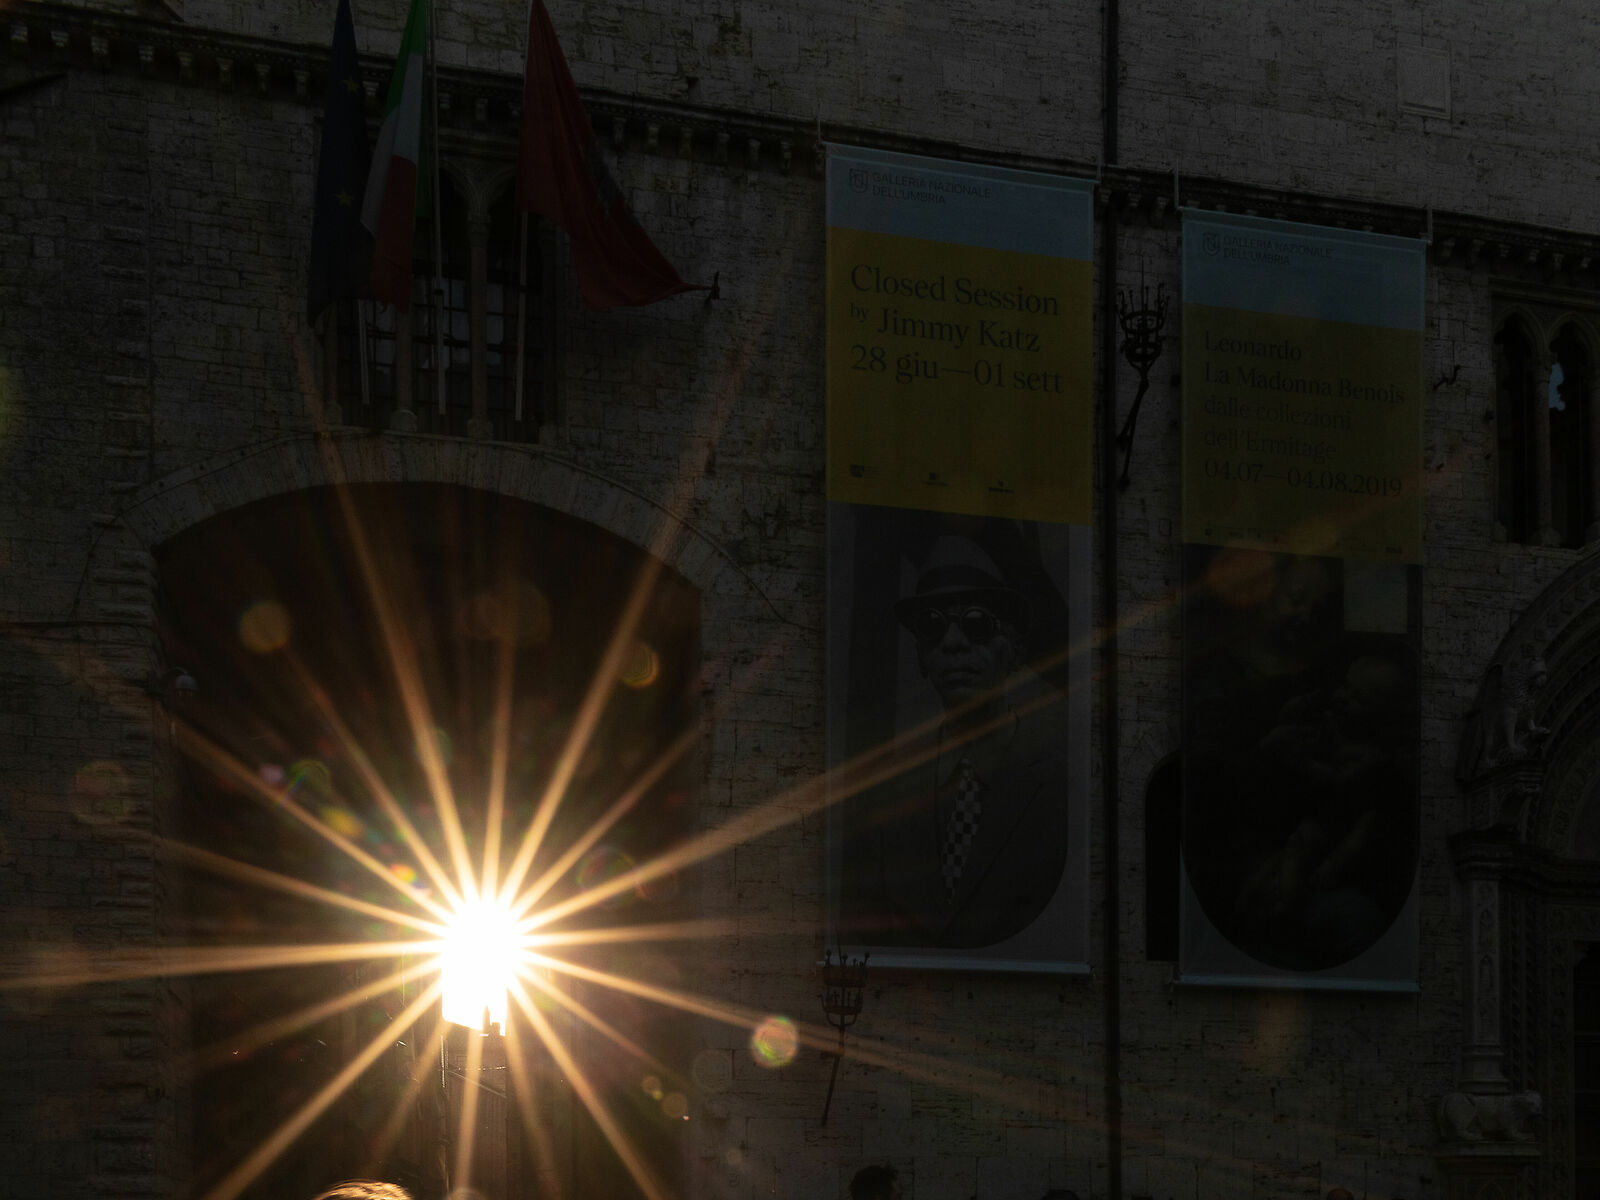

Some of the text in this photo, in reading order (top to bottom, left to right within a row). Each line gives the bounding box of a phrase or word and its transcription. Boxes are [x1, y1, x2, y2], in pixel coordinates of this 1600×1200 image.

[872, 172, 991, 199] GALLERIA NAZIONALE
[1223, 234, 1332, 258] GALLERIA NAZIONALE
[851, 264, 1058, 316] Closed Session
[850, 302, 1040, 352] by Jimmy Katz
[1205, 330, 1302, 361] Leonardo
[850, 344, 887, 373] 28
[1013, 369, 1064, 394] sett
[1205, 361, 1407, 405] La Madonna Benois
[1204, 394, 1352, 430] dalle collezioni
